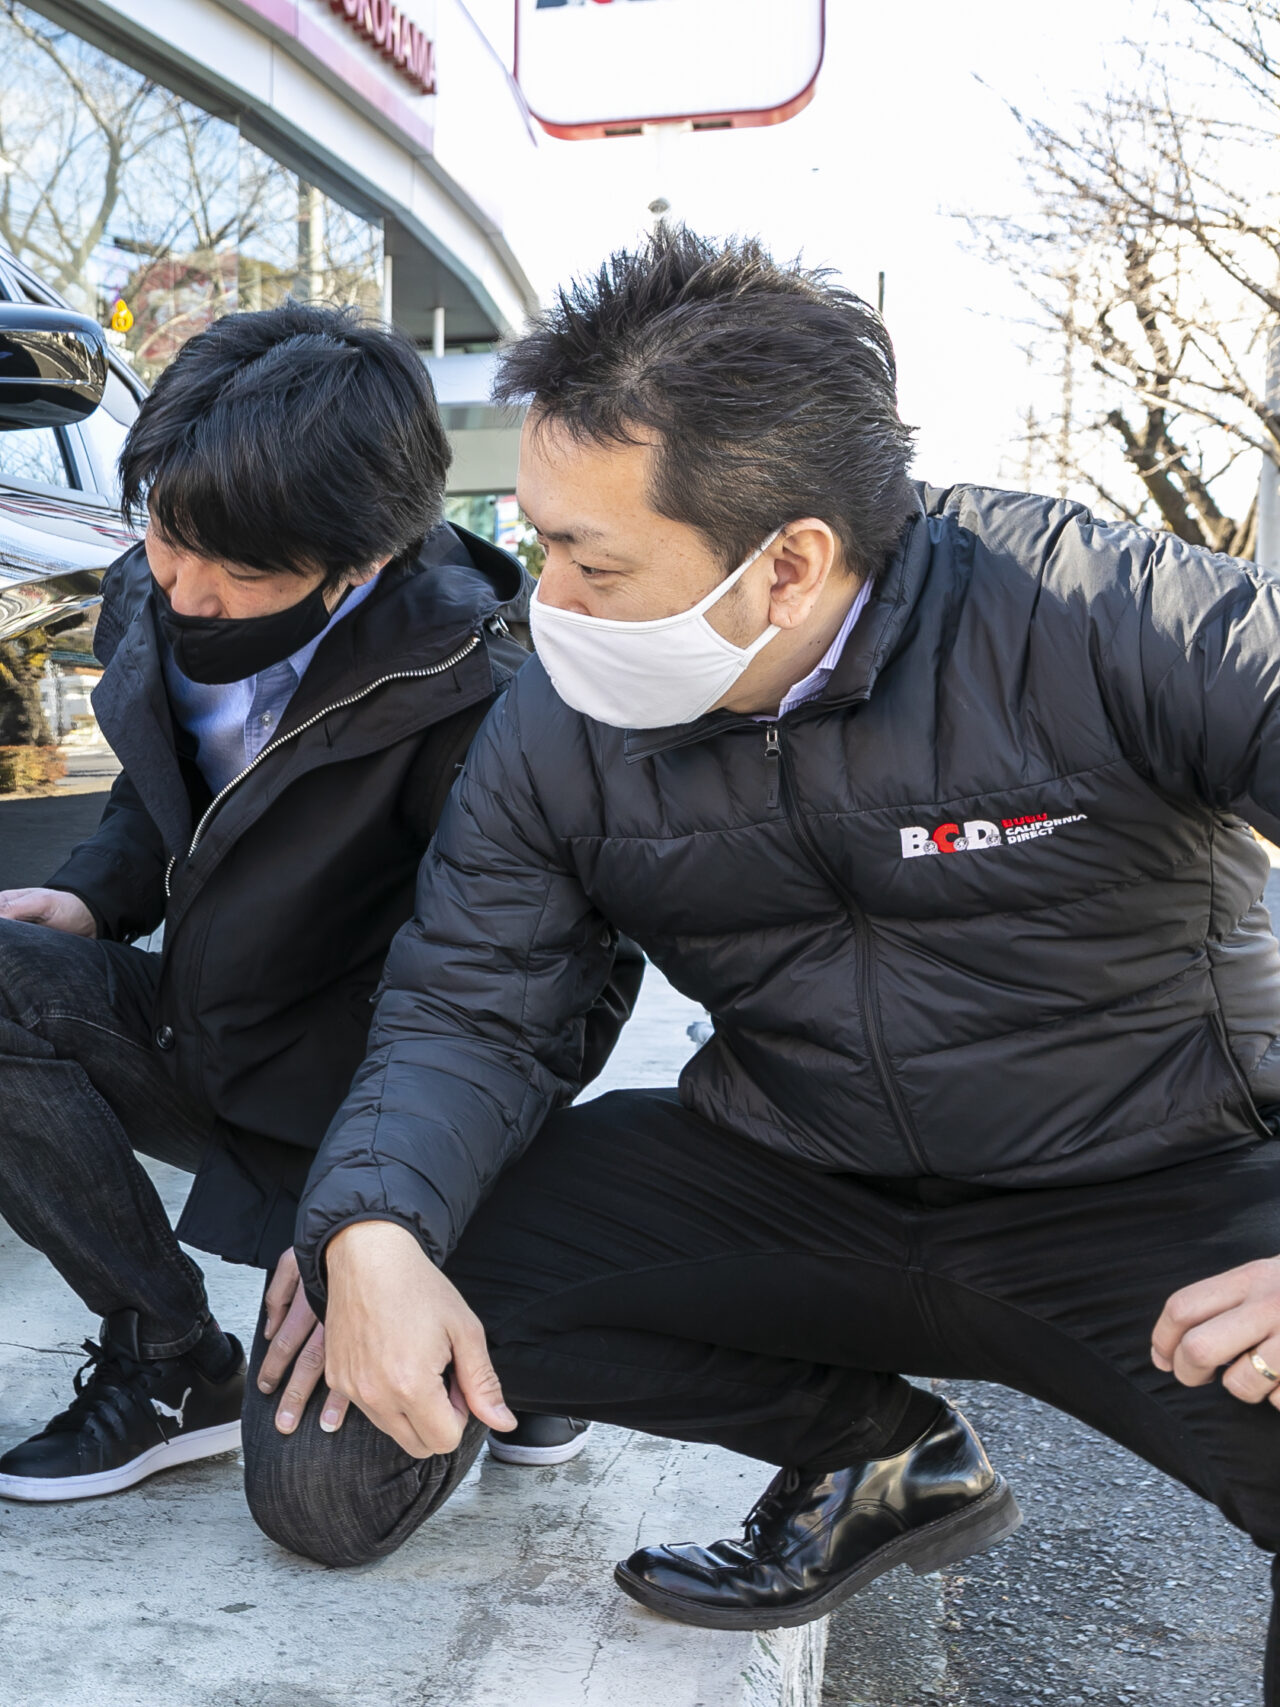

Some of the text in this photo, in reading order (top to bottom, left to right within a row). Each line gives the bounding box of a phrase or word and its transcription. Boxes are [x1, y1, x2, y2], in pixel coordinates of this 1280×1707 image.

[329, 0, 437, 95] KOHAMA
[1004, 813, 1088, 836] CALIFORNIA
[1006, 826, 1055, 845] DIRECT
